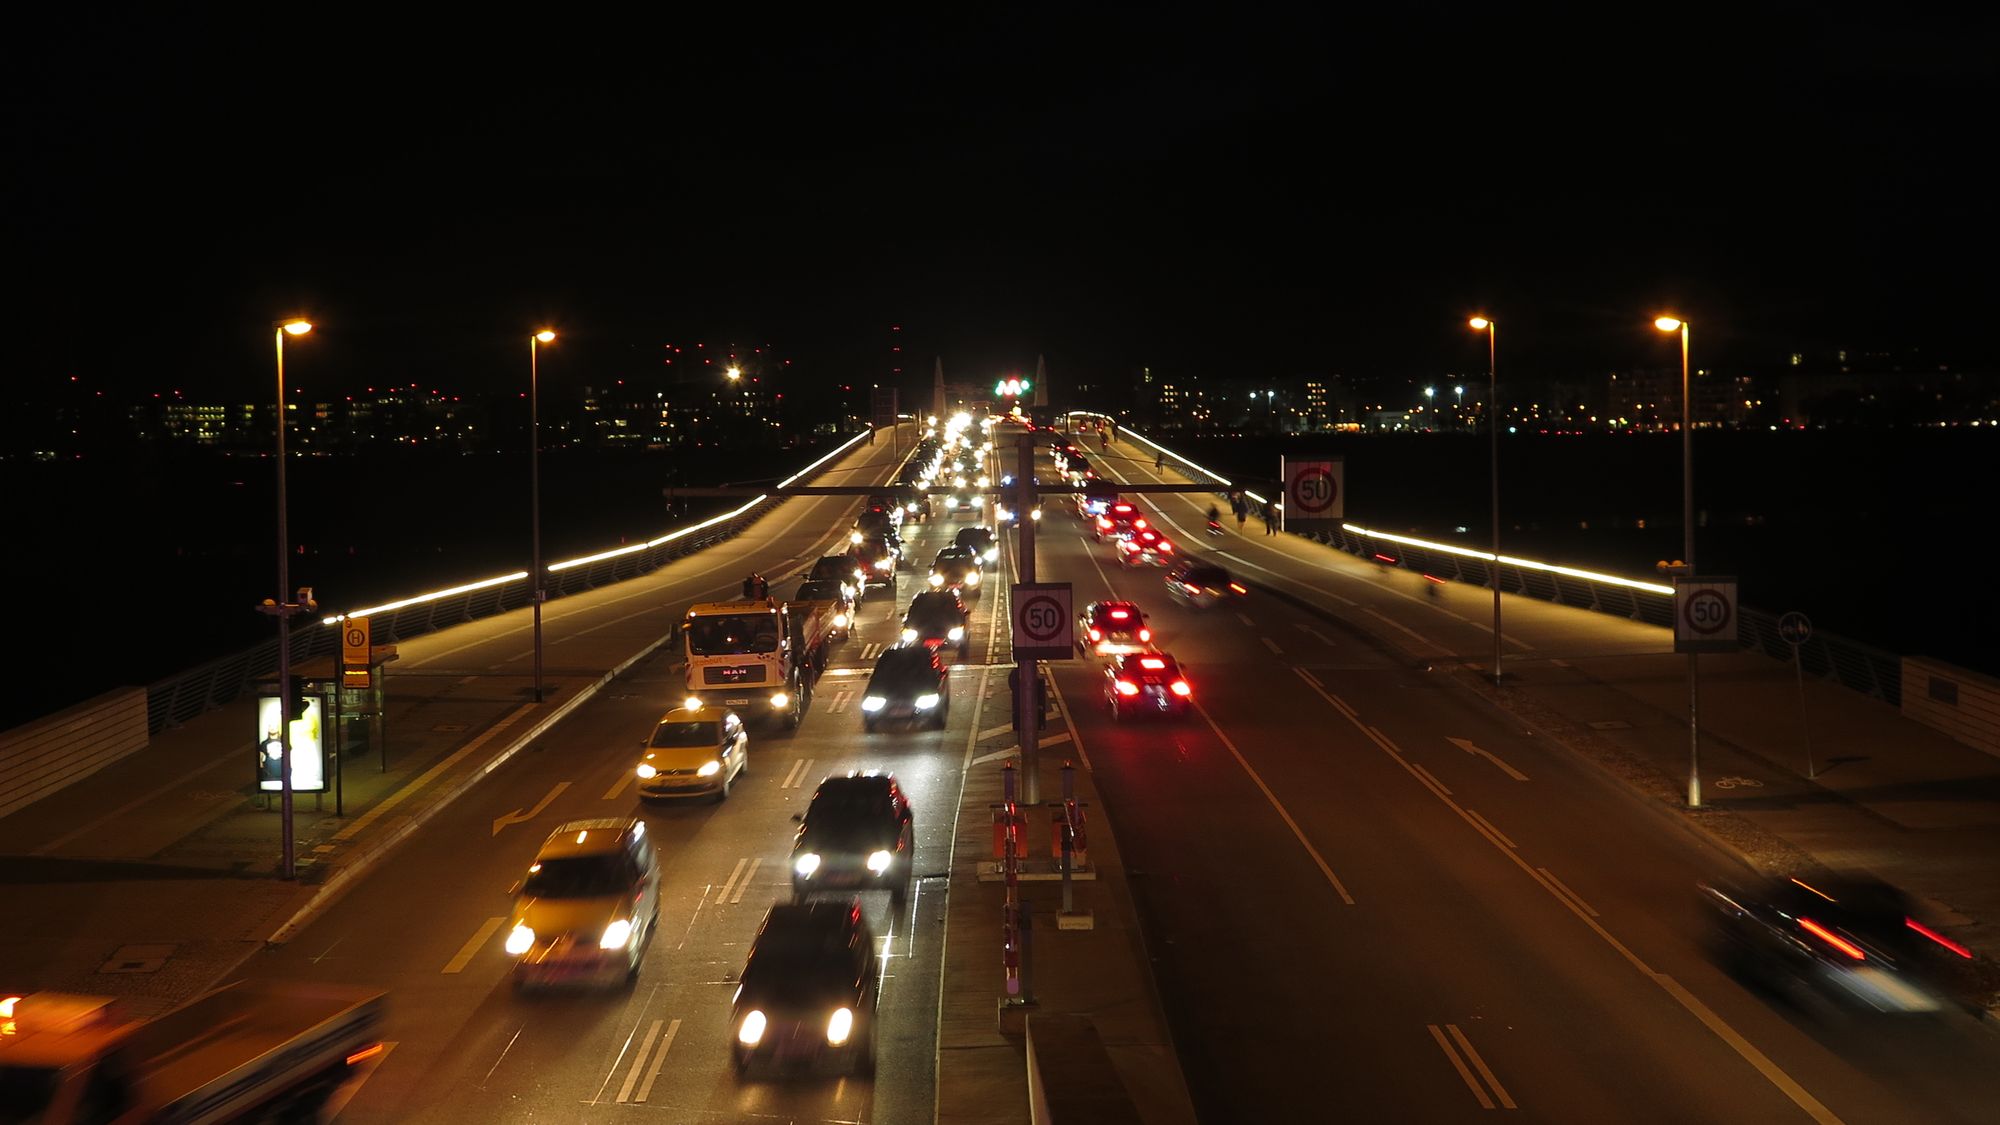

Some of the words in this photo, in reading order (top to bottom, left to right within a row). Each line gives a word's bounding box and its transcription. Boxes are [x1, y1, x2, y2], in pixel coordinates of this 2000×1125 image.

[1302, 480, 1327, 500] 50
[1030, 608, 1056, 628] 50
[1695, 601, 1721, 622] 50
